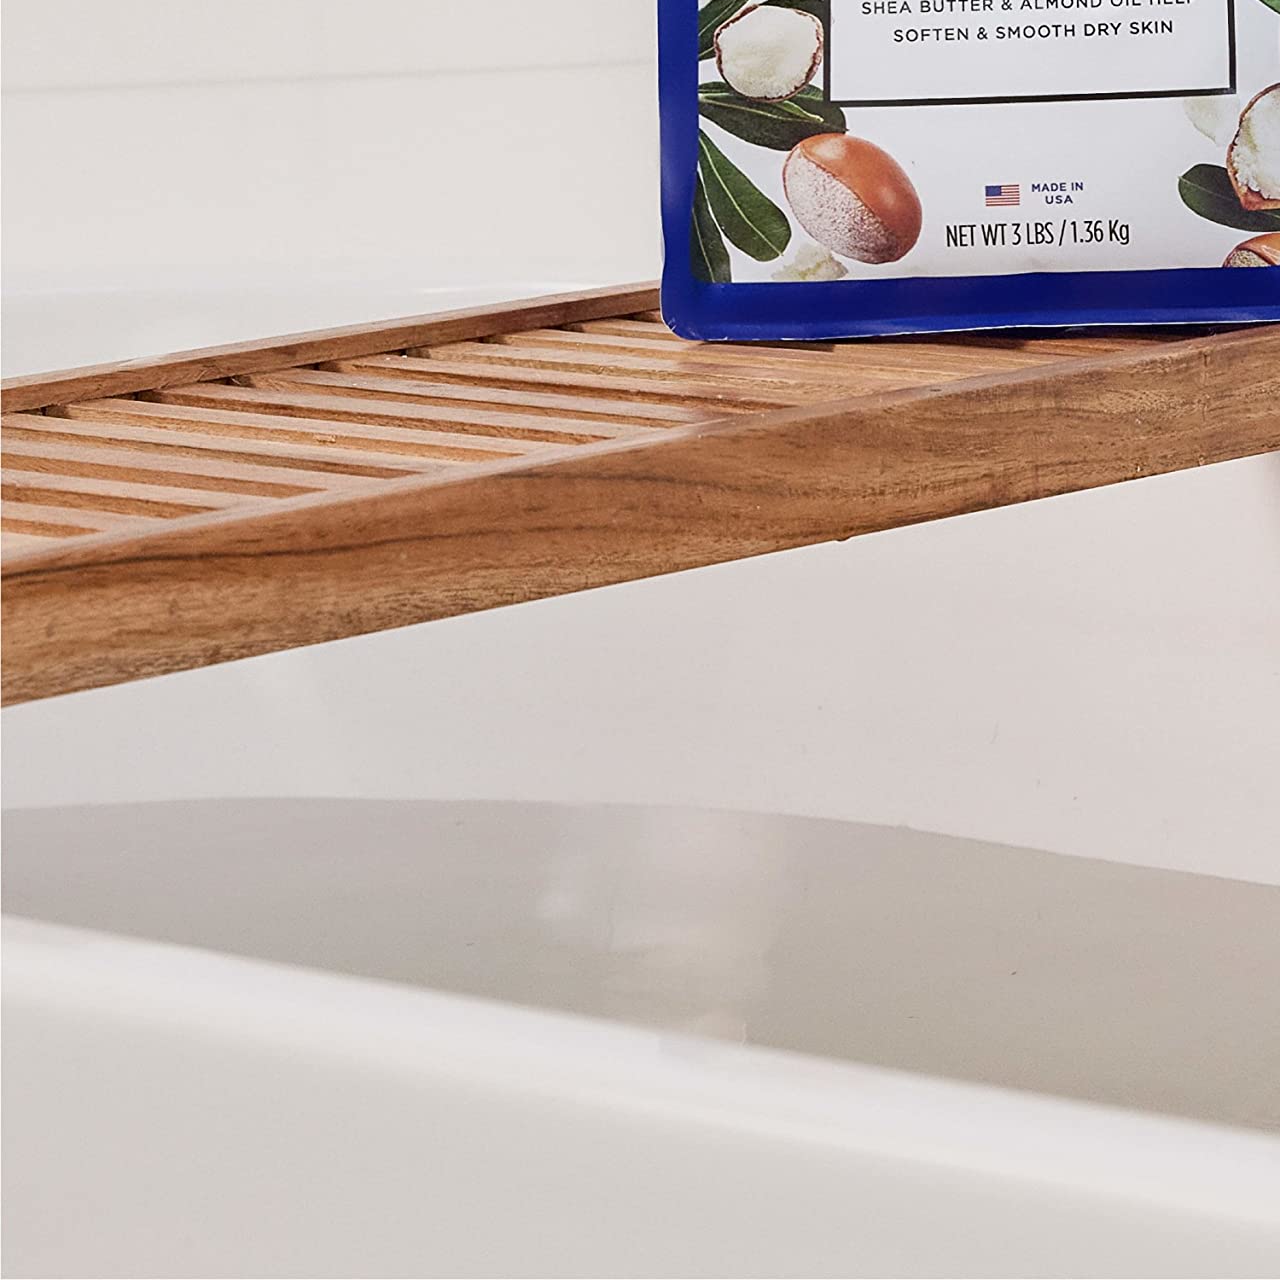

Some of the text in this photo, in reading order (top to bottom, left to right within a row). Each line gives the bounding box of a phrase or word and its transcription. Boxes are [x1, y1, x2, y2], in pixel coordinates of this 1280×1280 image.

[861, 0, 912, 15] SHEA
[893, 20, 1173, 43] SOFTEN & SMOOTH DRY SKIN
[1031, 181, 1084, 193] MADE IN
[1045, 194, 1074, 205] USA
[946, 219, 1130, 248] NET WT 3 LBS / 1.36 Kg
